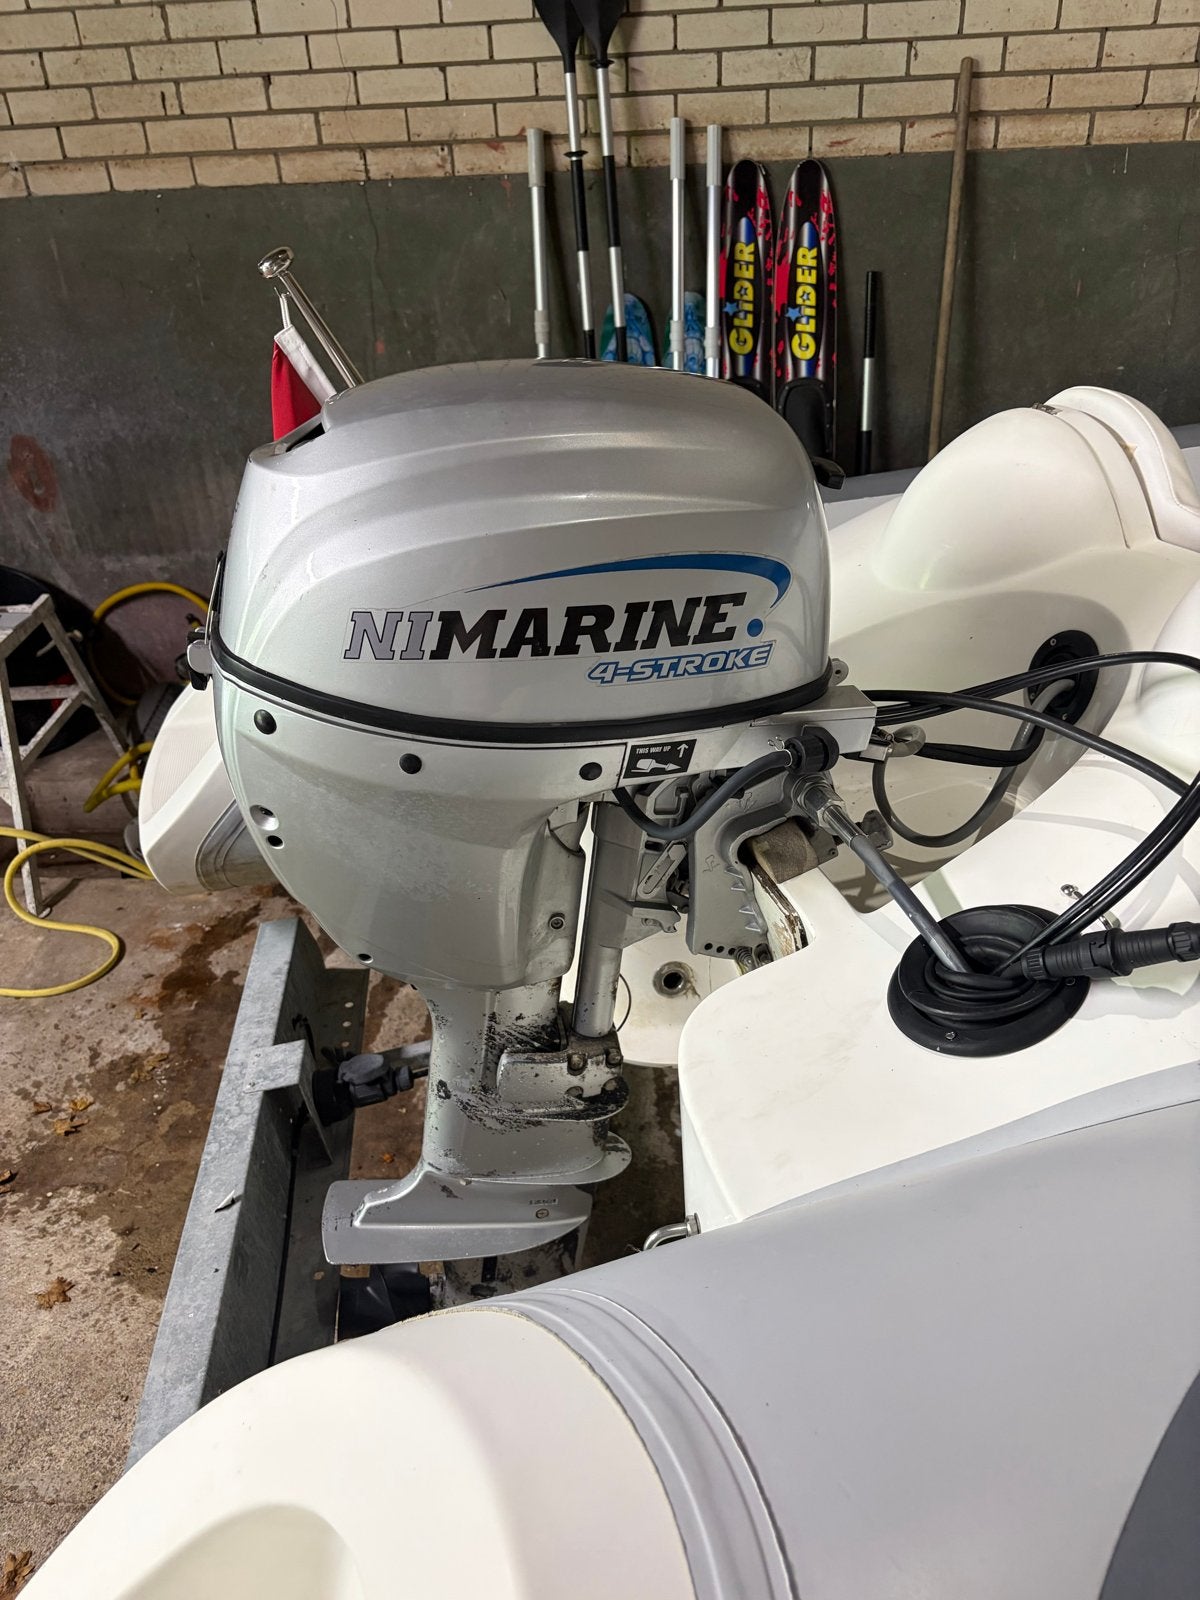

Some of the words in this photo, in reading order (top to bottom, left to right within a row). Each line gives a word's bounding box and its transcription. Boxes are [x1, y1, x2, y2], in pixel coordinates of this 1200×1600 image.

[587, 643, 774, 685] 4-STROKE
[635, 747, 650, 755] THIS
[650, 746, 663, 754] WAY
